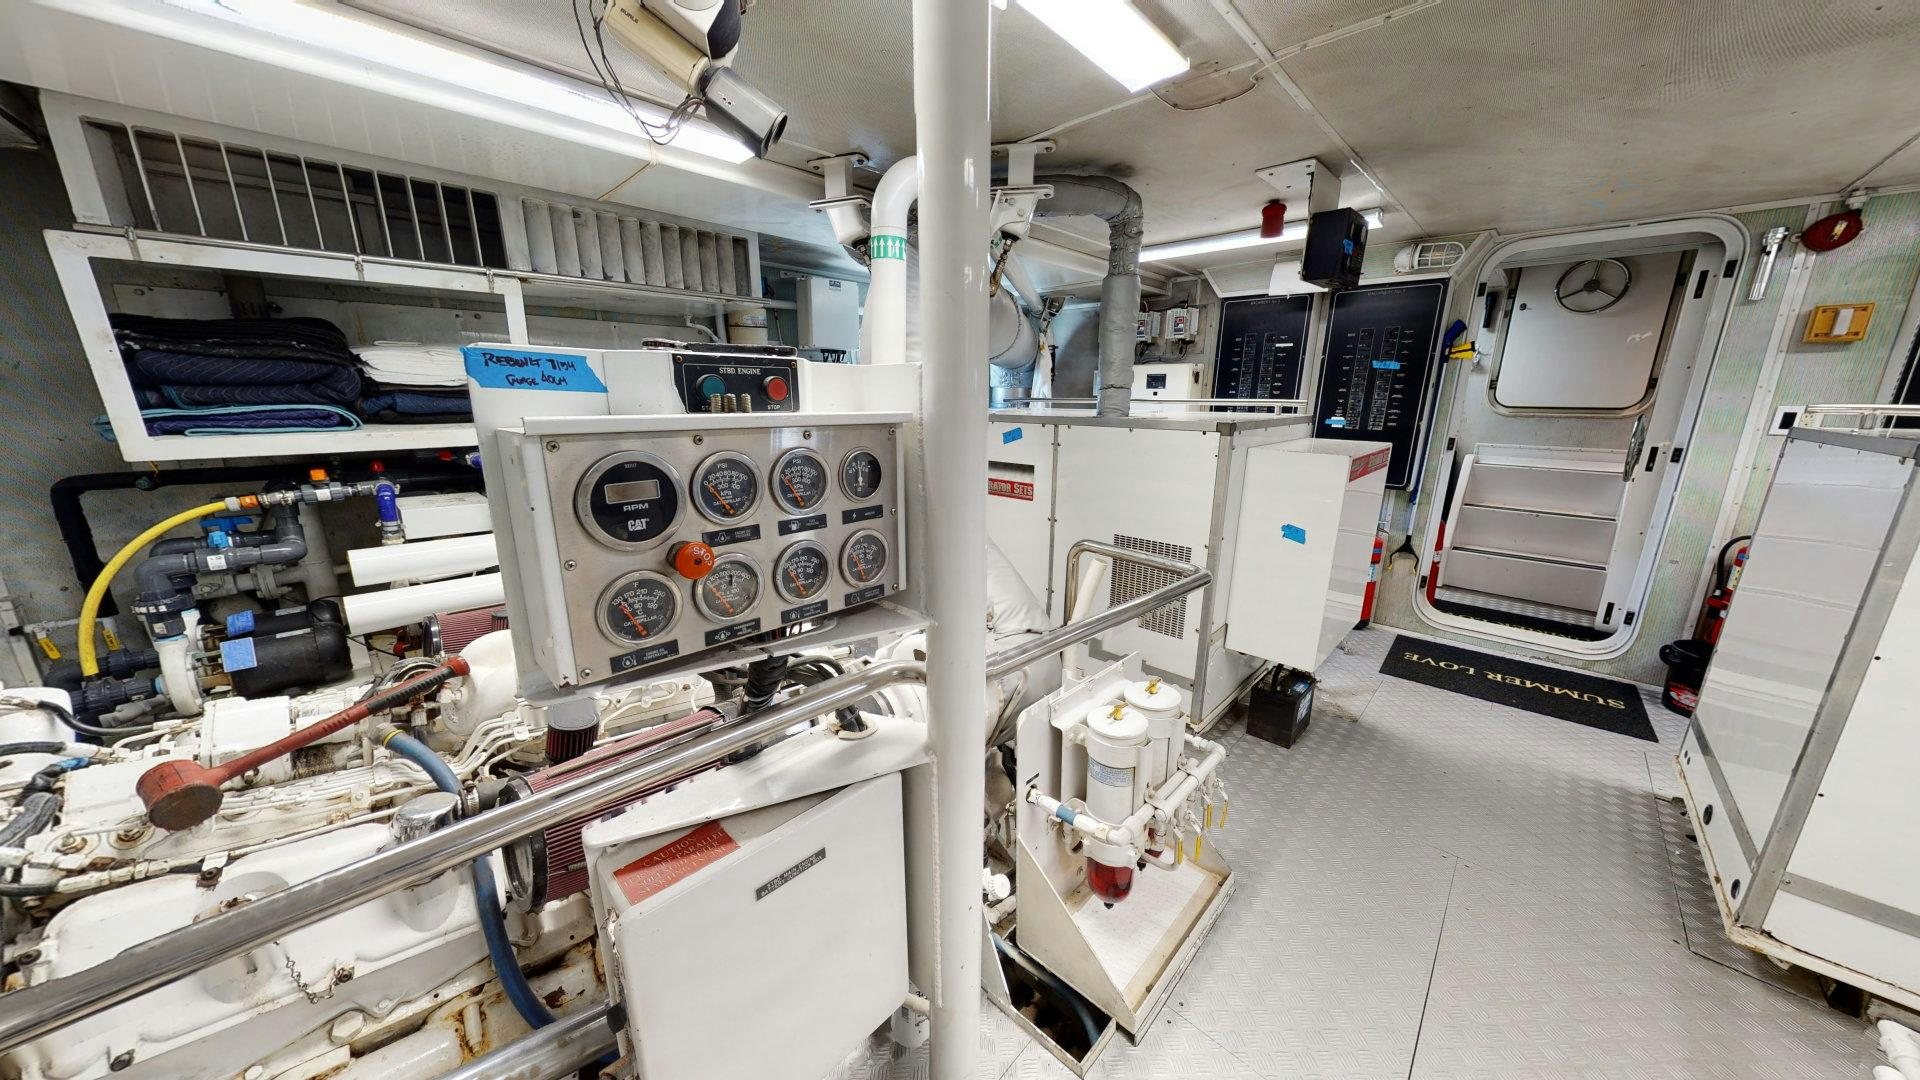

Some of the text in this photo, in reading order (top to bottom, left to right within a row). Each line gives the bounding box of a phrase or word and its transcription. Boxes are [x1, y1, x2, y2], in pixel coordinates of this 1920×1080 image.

[1014, 483, 1033, 496] SETS
[623, 503, 649, 512] RPM
[627, 518, 648, 532] CAT
[692, 546, 713, 566] STOP
[1403, 652, 1626, 710] SUMMER LOVE
[643, 835, 697, 867] CAUTION
[677, 830, 726, 859] PARALLEL
